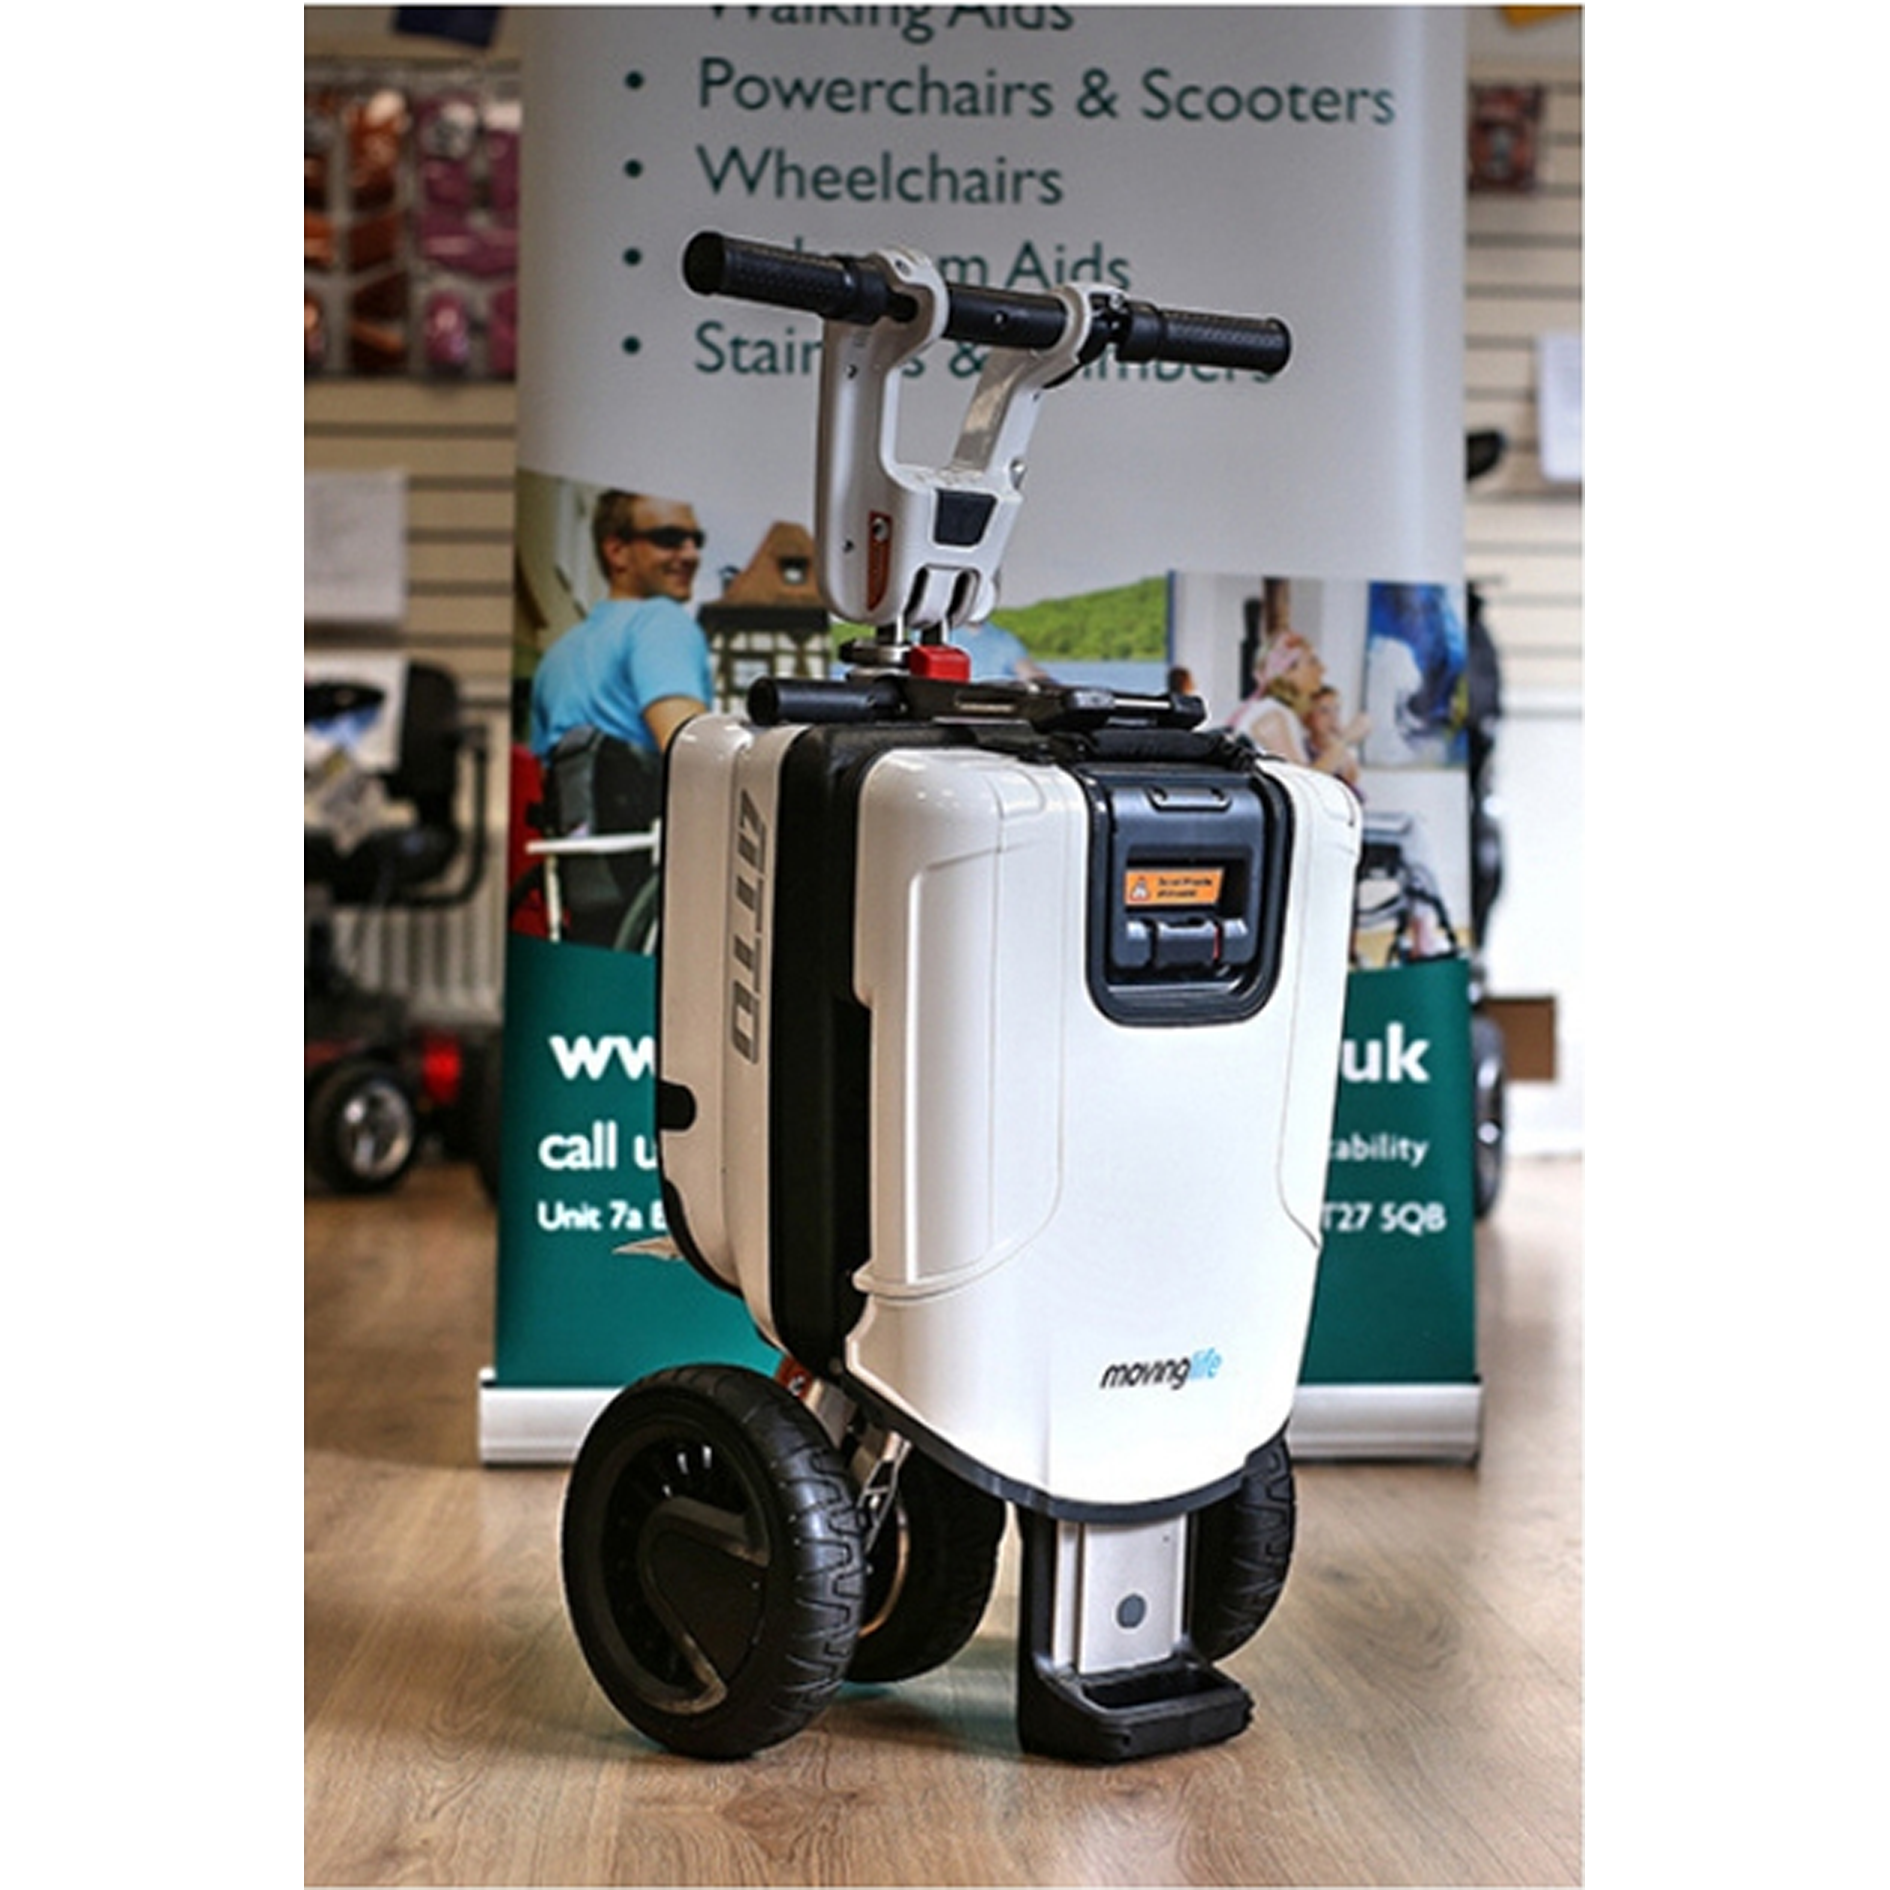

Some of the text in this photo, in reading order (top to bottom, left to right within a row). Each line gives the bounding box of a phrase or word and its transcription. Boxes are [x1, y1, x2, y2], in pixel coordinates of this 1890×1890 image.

[699, 56, 1396, 125] Powerchairs & Scooters
[696, 143, 1064, 205] Wheelchairs
[1005, 240, 1131, 290] Aids
[1341, 1021, 1431, 1084] uk
[538, 1119, 617, 1170] call
[537, 1199, 602, 1231] Unit
[609, 1199, 643, 1231] 7a
[1322, 1201, 1374, 1232] T27
